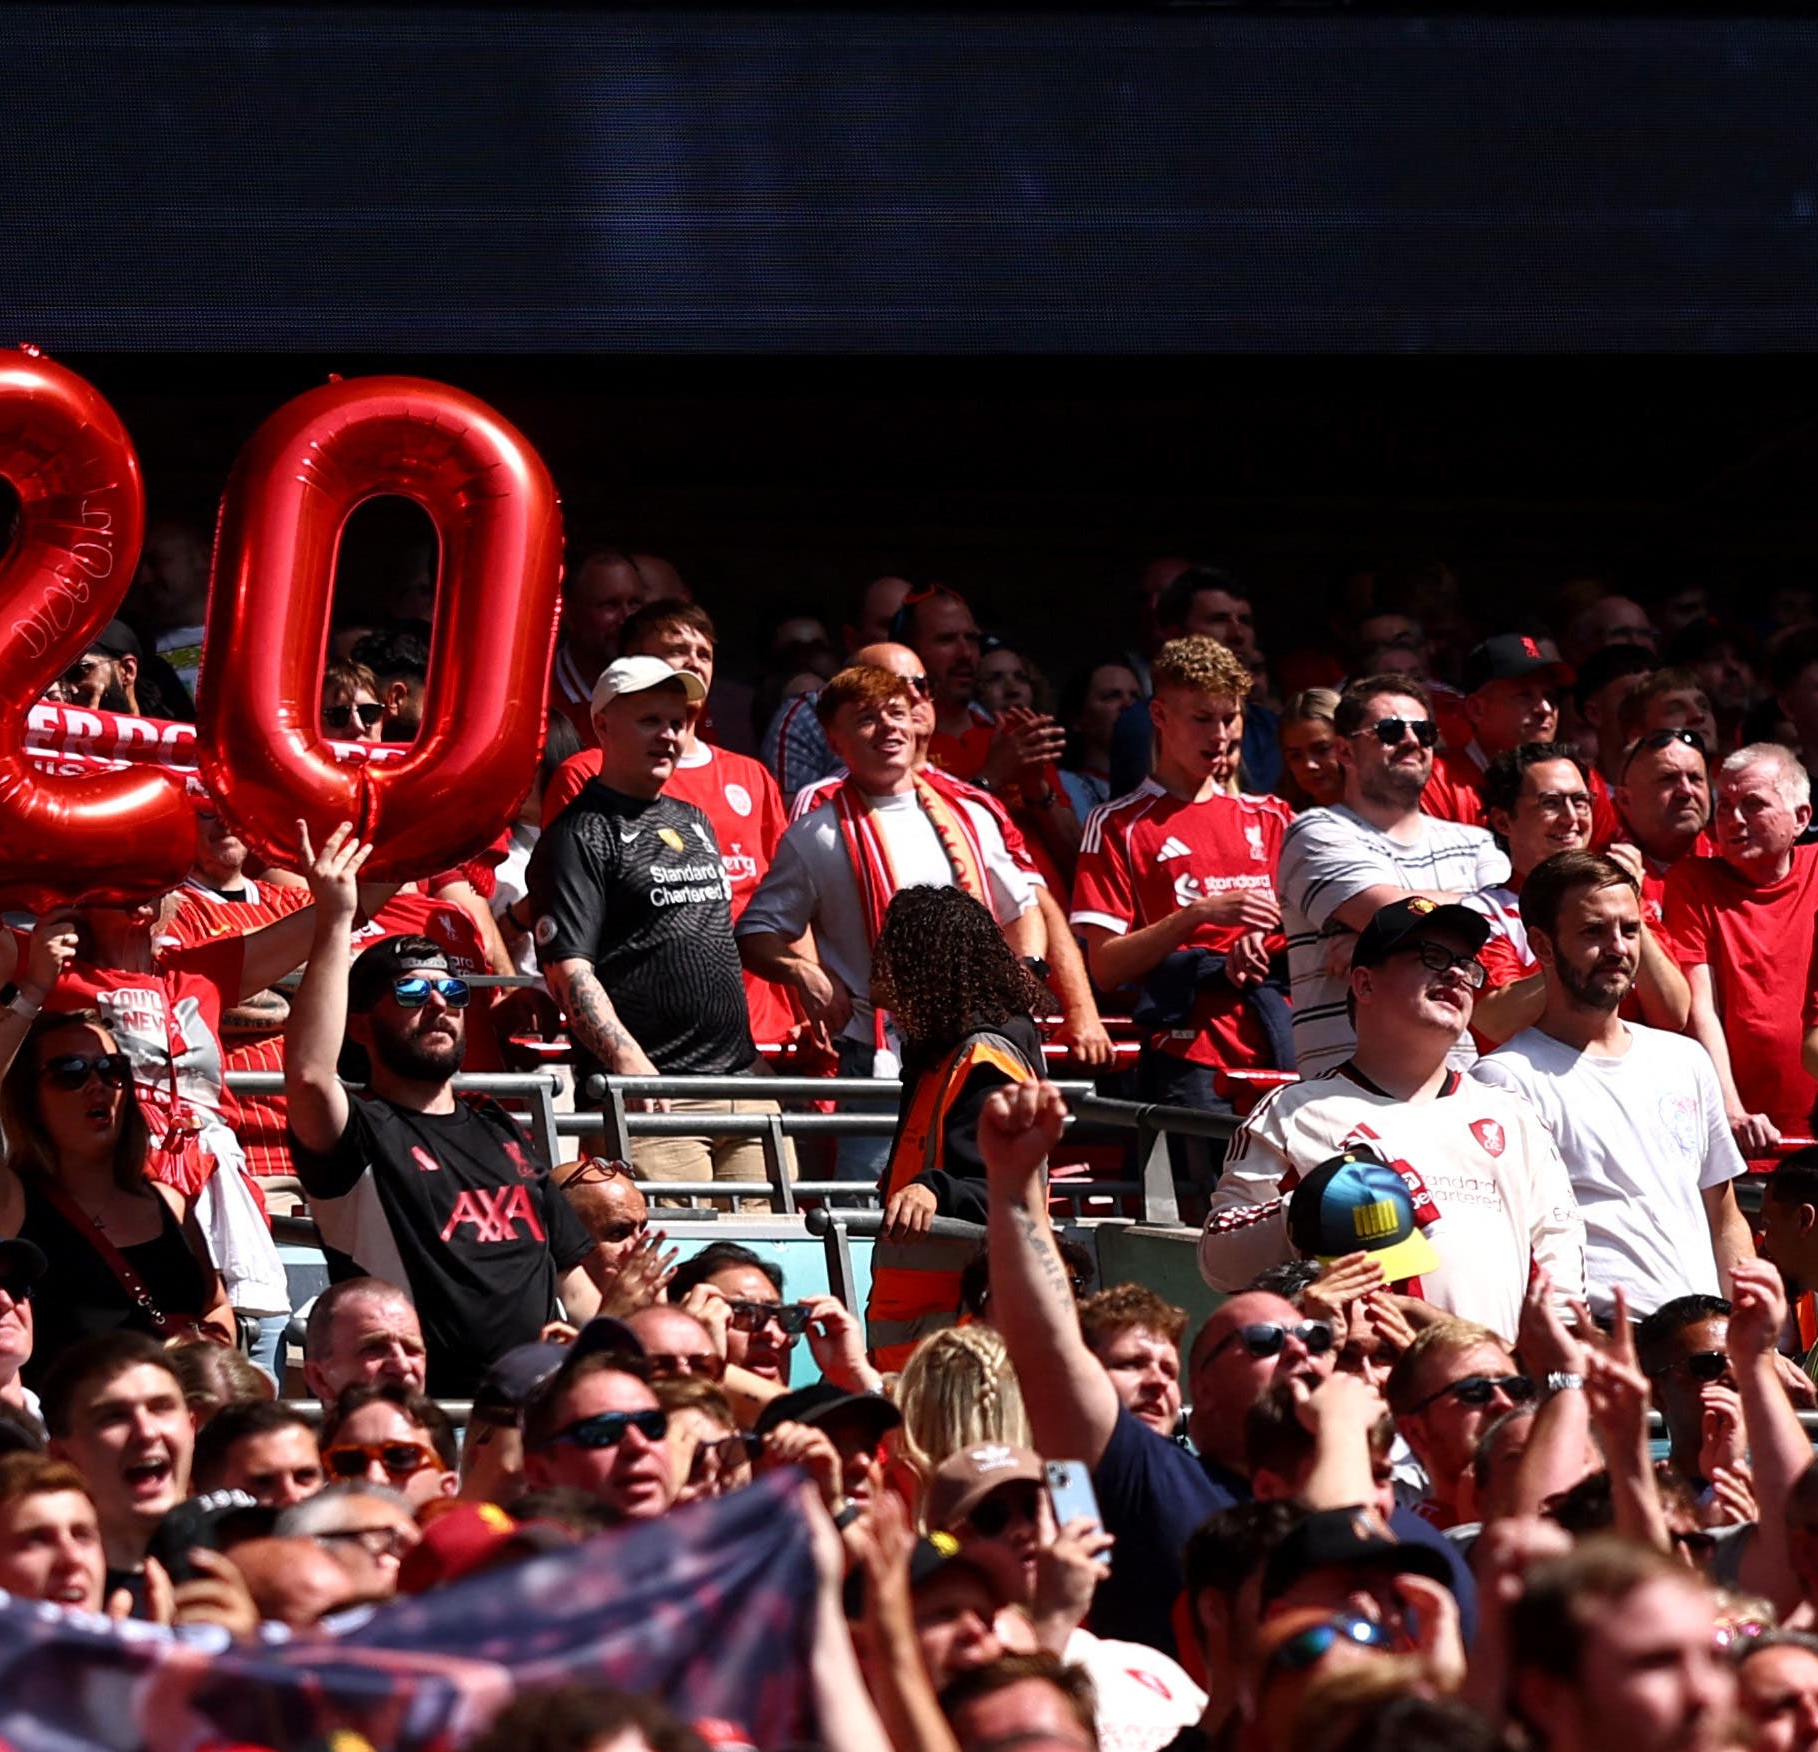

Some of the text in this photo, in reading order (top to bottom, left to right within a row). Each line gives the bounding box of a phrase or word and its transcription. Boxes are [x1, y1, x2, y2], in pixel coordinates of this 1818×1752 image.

[650, 863, 717, 884] Standard
[650, 883, 723, 907] Chartered
[1424, 1174, 1496, 1195] andard
[439, 1183, 547, 1243] AXA
